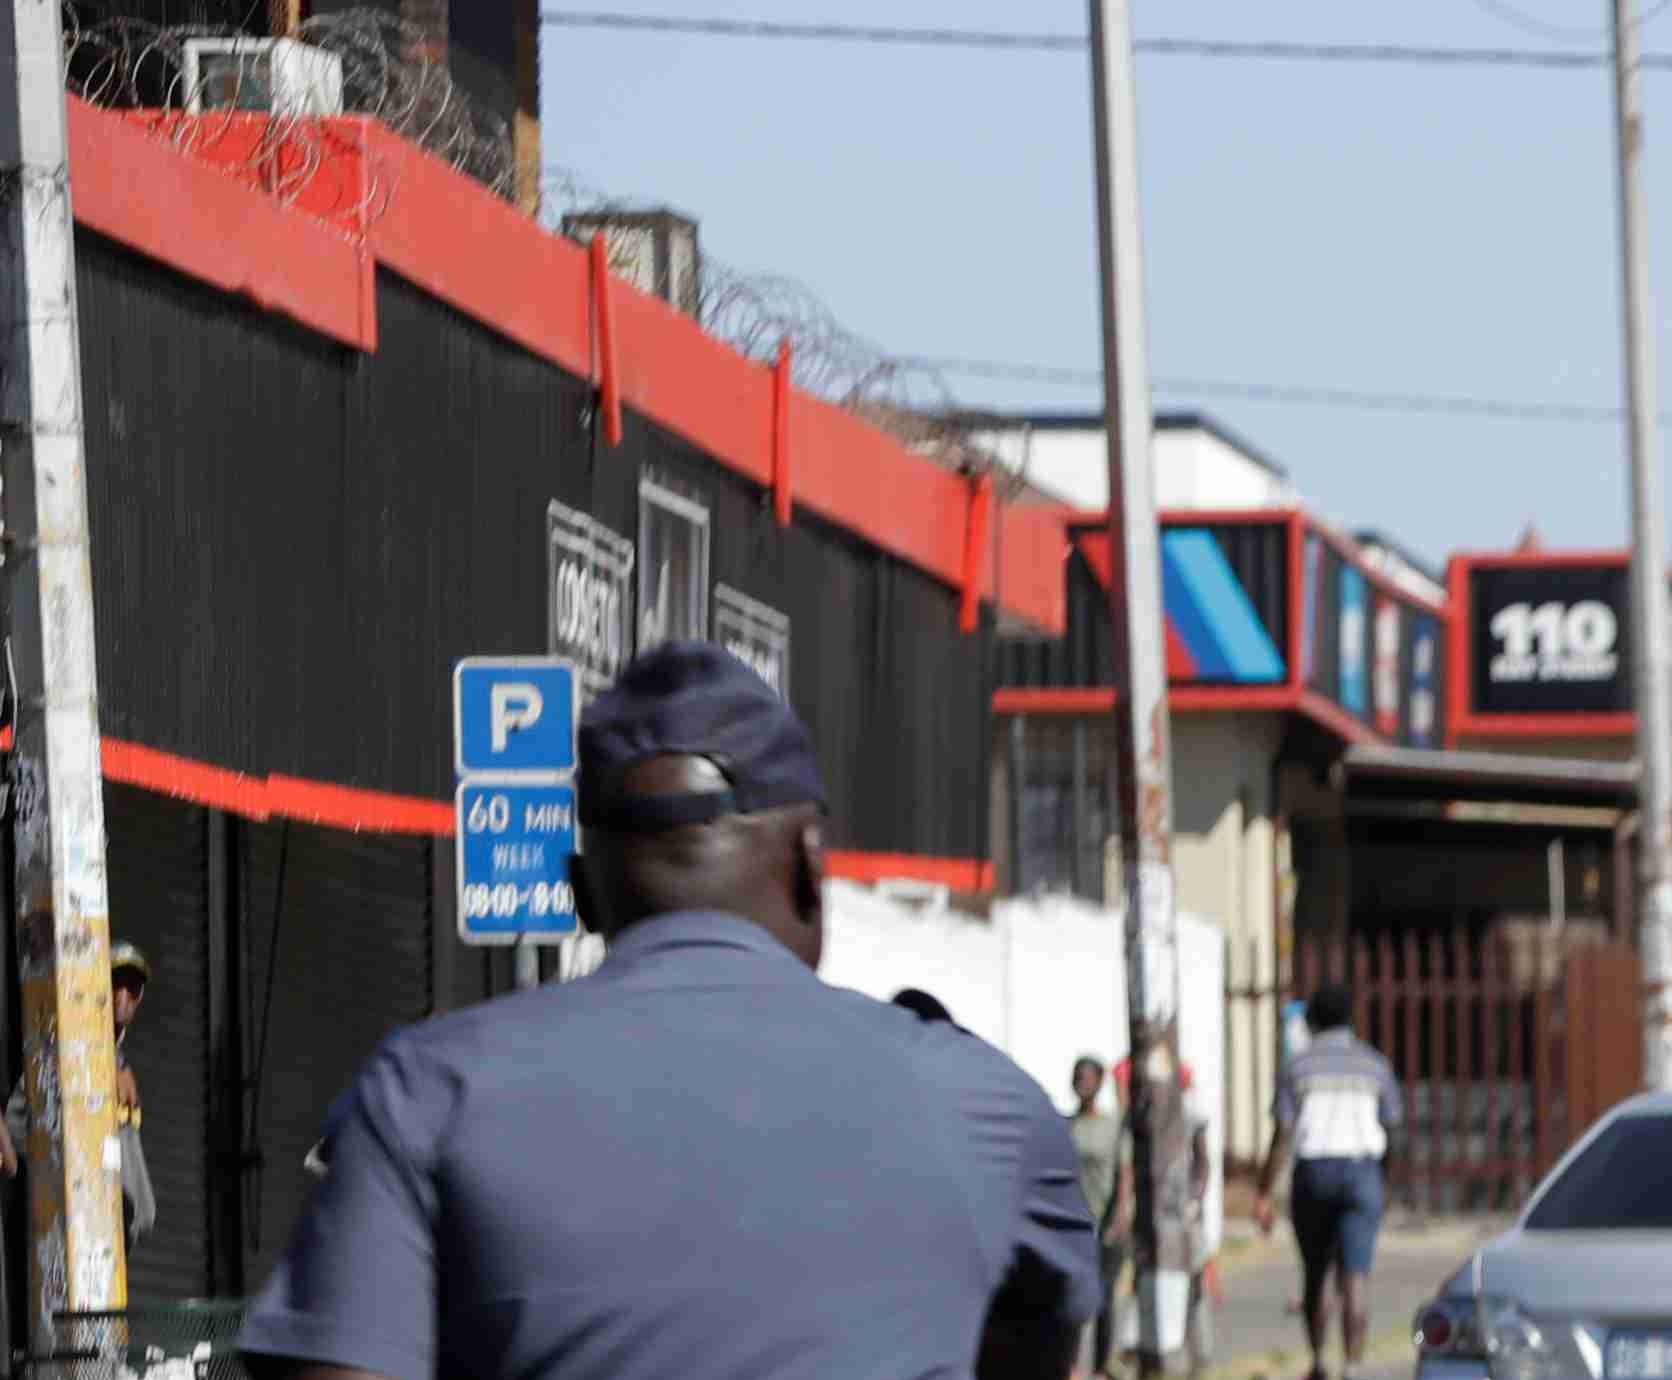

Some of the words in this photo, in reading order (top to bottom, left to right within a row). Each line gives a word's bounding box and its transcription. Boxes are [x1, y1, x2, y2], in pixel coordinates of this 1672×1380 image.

[1490, 600, 1617, 658] 110
[491, 683, 543, 752] P
[468, 795, 509, 833] 60
